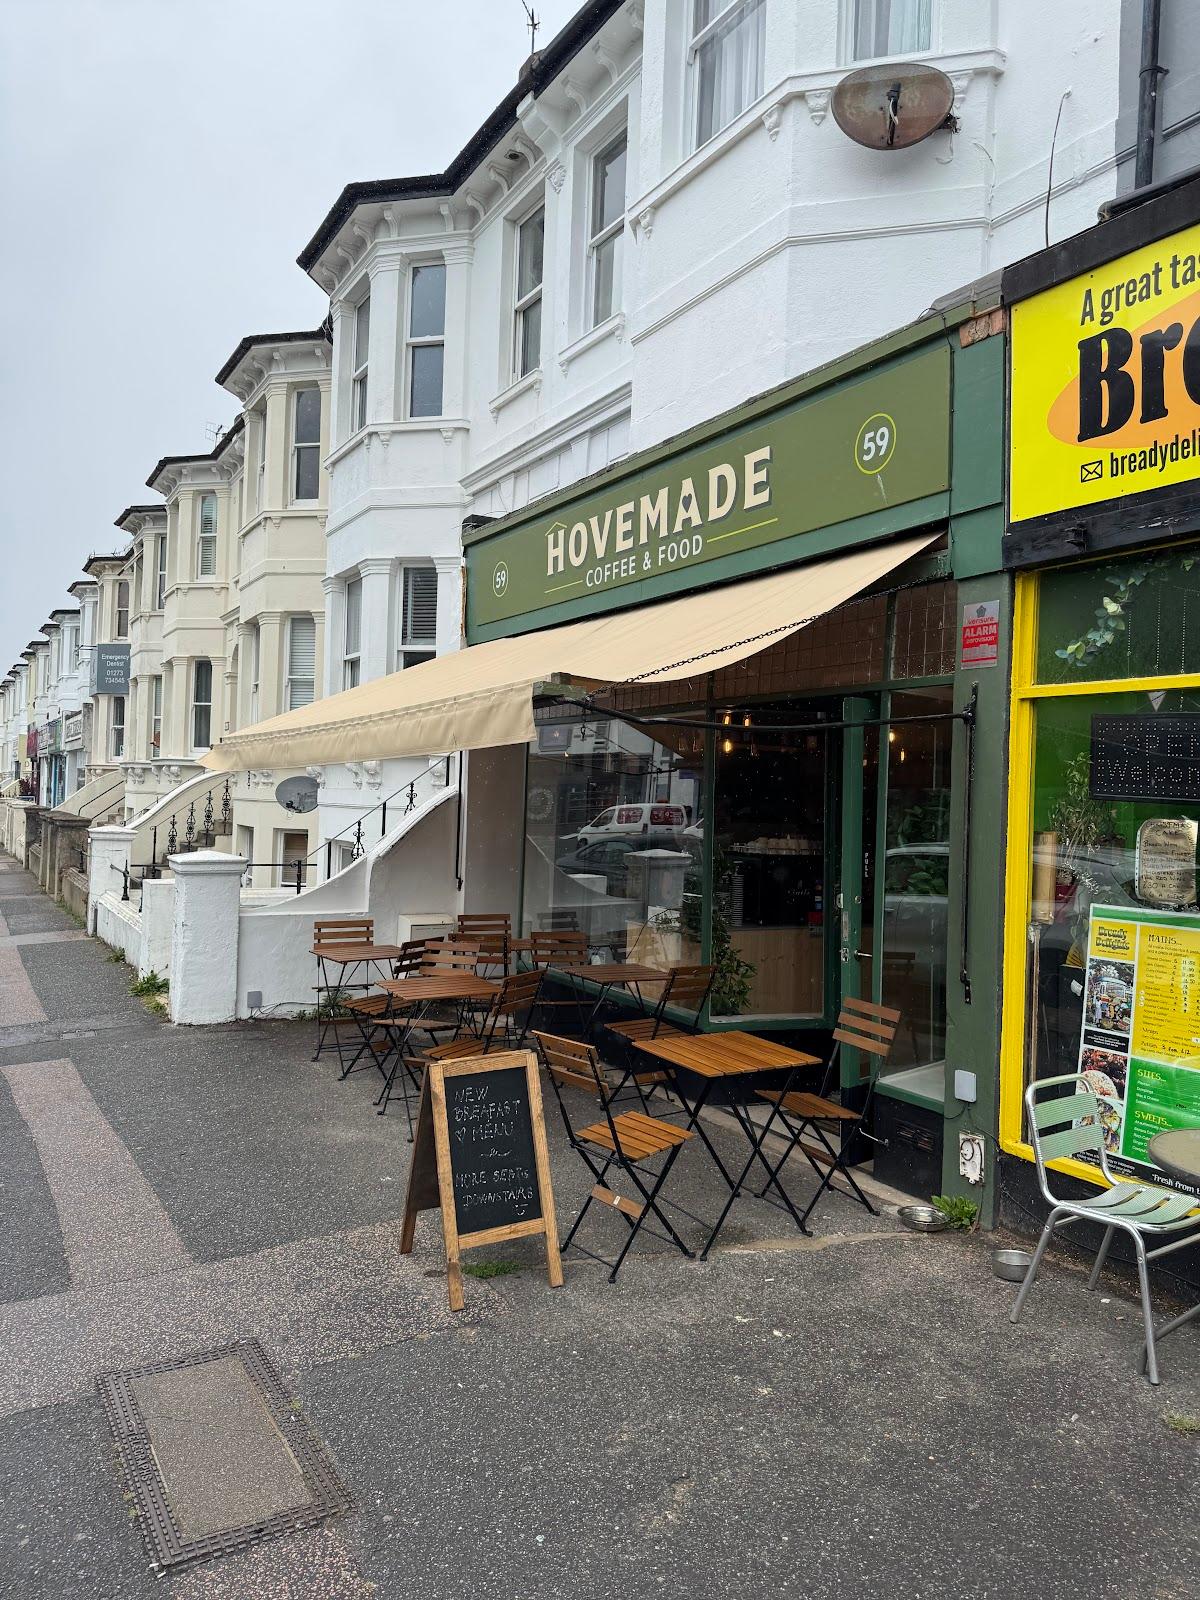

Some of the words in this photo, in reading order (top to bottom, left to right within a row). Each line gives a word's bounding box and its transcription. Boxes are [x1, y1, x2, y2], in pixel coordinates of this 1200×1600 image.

[1081, 288, 1095, 326] A
[1099, 261, 1162, 326] great
[1170, 254, 1200, 288] ta
[863, 425, 889, 462] 59
[546, 445, 773, 577] HOVEMADE
[585, 555, 636, 587] COFFEE
[642, 550, 652, 571] &
[658, 534, 703, 566] FOOD
[494, 571, 507, 589] 59
[965, 625, 997, 638] ALARM
[454, 1085, 489, 1104] NEW
[472, 1120, 514, 1142] MENU
[455, 1170, 487, 1189] MORE
[492, 1166, 529, 1186] SEATS
[1174, 1179, 1195, 1195] from
[462, 1185, 534, 1208] DOWNSTAIRS
[127, 1431, 154, 1482] TELEGRAPHS
